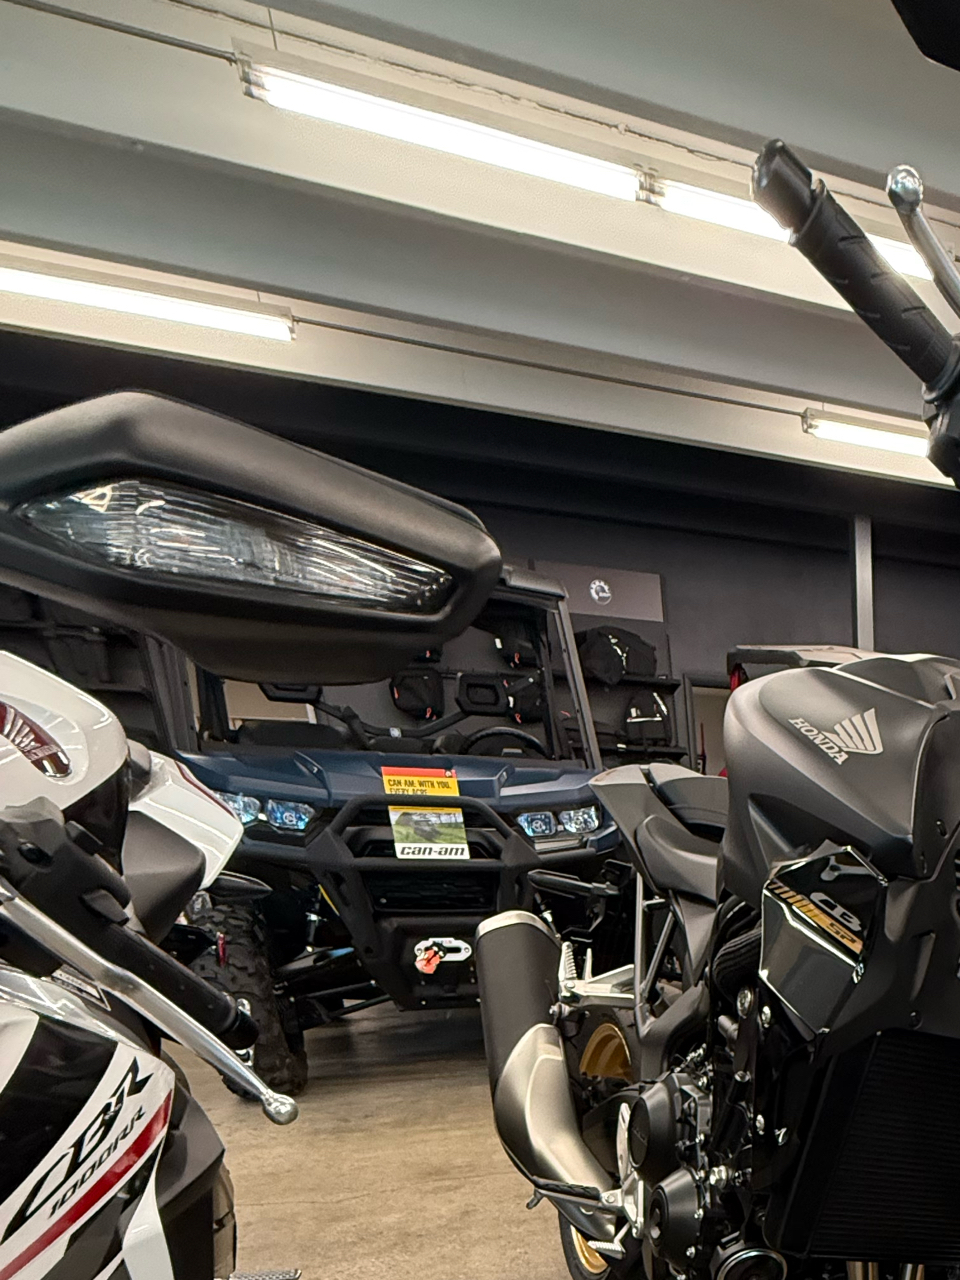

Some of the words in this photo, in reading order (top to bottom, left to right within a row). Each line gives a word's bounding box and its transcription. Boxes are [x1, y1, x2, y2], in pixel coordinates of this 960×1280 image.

[788, 717, 848, 765] HONDA
[387, 779, 402, 787] CAN
[418, 780, 435, 789] WITH
[810, 892, 862, 931] CB
[825, 922, 857, 944] SP
[1, 1056, 154, 1242] CBR
[48, 1105, 146, 1219] 1000RR
